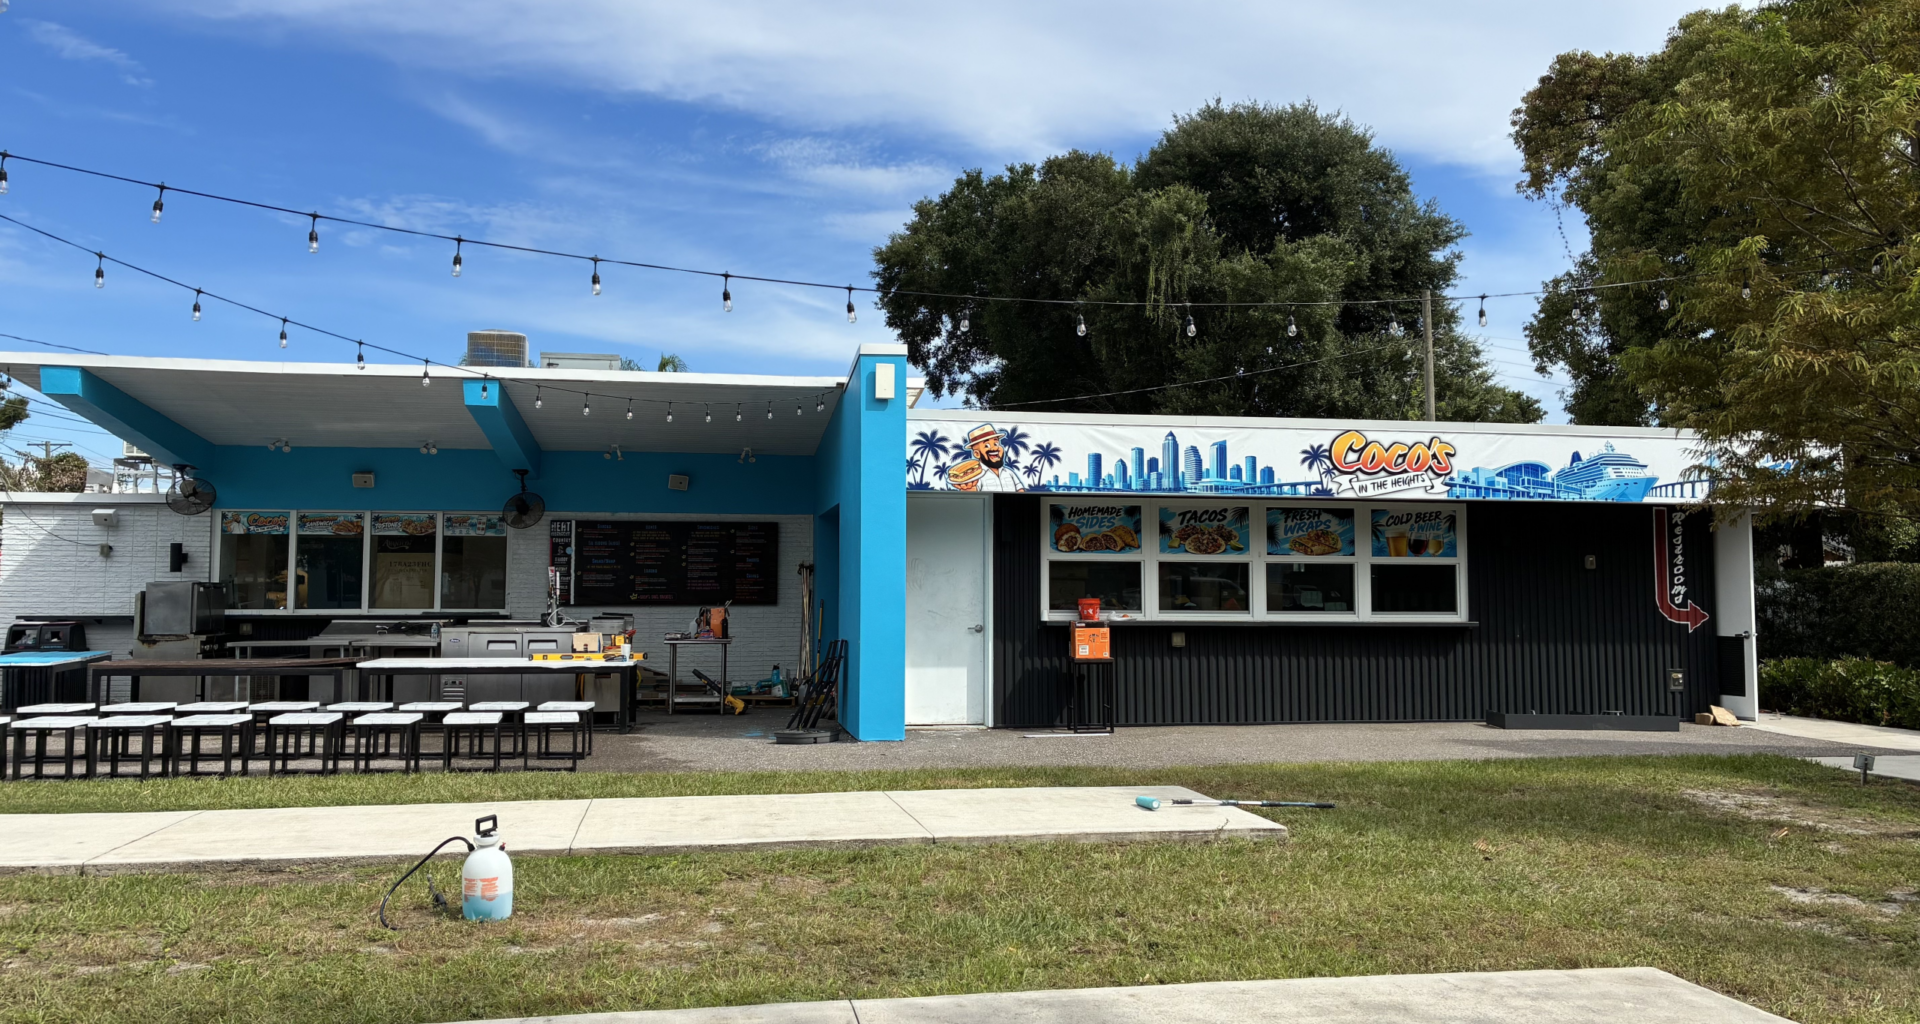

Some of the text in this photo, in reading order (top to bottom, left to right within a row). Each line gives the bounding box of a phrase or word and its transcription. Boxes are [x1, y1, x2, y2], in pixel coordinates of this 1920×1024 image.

[1358, 473, 1425, 493] IN THE HEIGHTS
[1068, 506, 1123, 518] HOMEMADE
[1178, 508, 1229, 525] TACOS
[1283, 509, 1322, 523] FRESH
[1386, 510, 1443, 527] COLD BEER
[1074, 516, 1117, 529] SIDES
[1283, 519, 1332, 536] WRAPS
[1408, 521, 1443, 532] & WINE
